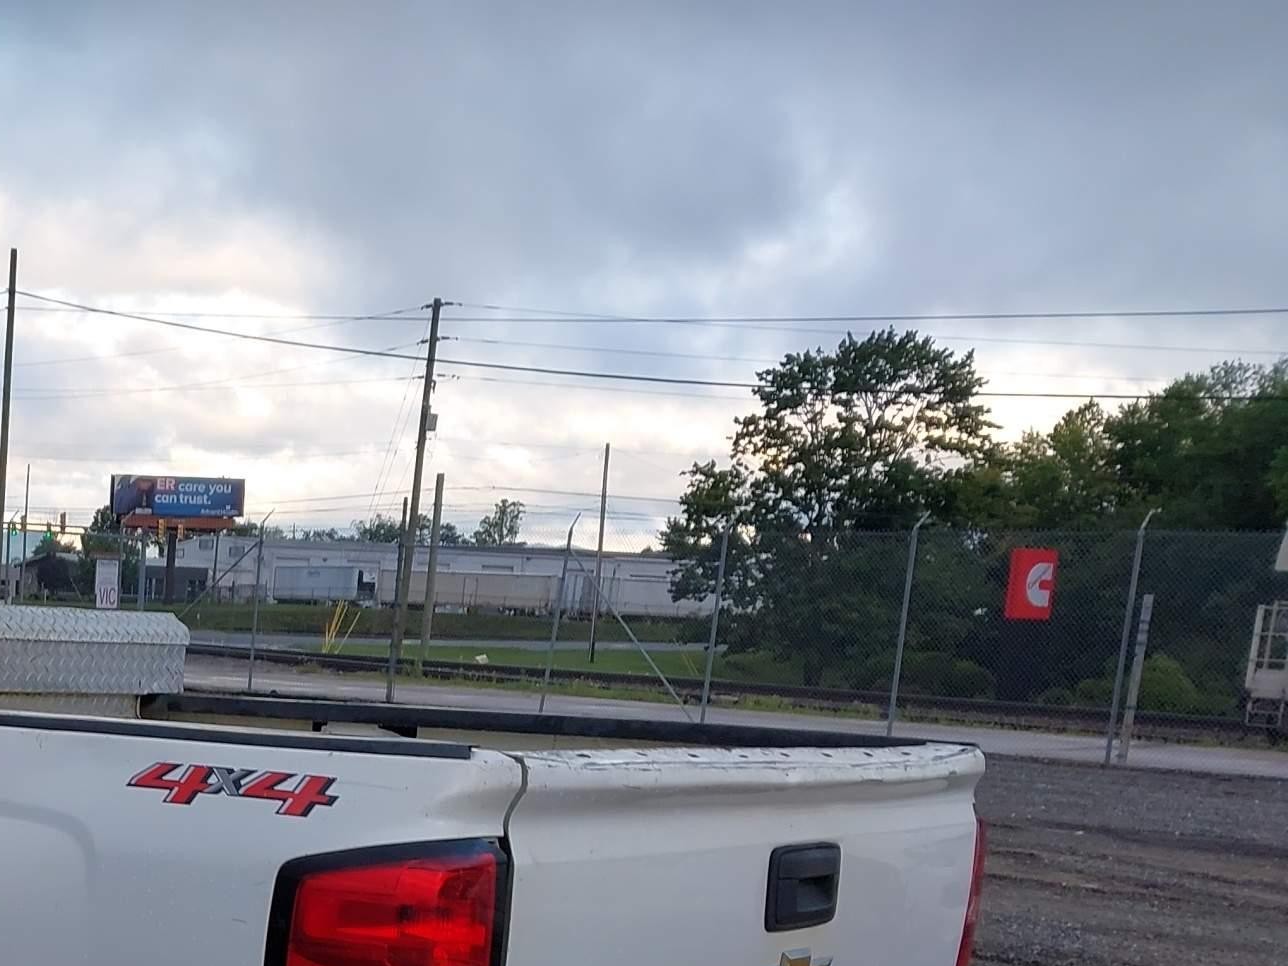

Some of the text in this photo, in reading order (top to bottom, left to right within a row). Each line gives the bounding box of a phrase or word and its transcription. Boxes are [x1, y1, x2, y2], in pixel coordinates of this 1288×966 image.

[156, 477, 232, 496] ER care you
[154, 493, 212, 505] can trust.
